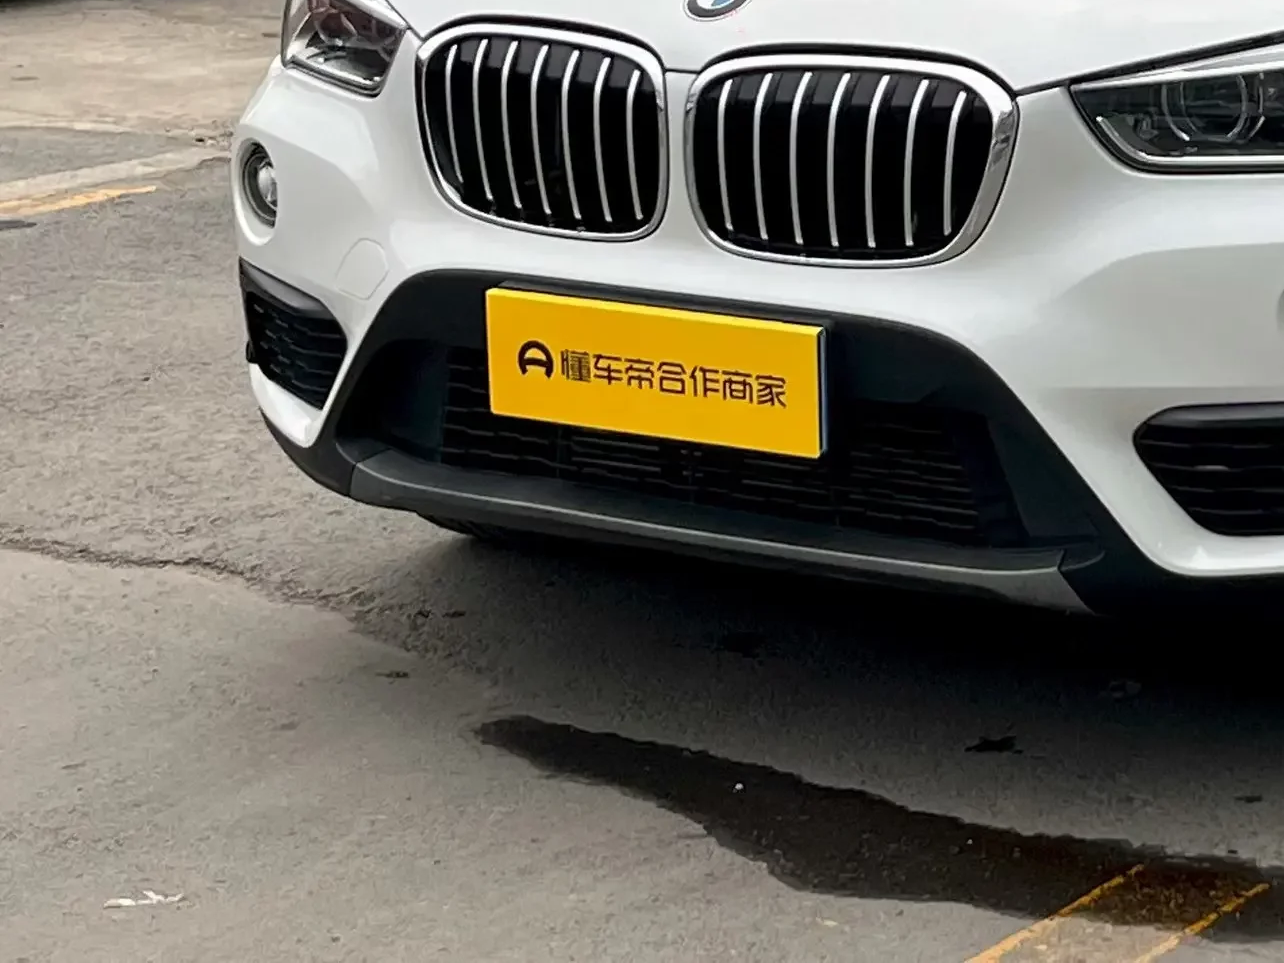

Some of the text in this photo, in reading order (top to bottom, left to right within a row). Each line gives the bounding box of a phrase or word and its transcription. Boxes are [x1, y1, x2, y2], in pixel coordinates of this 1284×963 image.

[560, 348, 787, 409] 懂车帝合作商家
